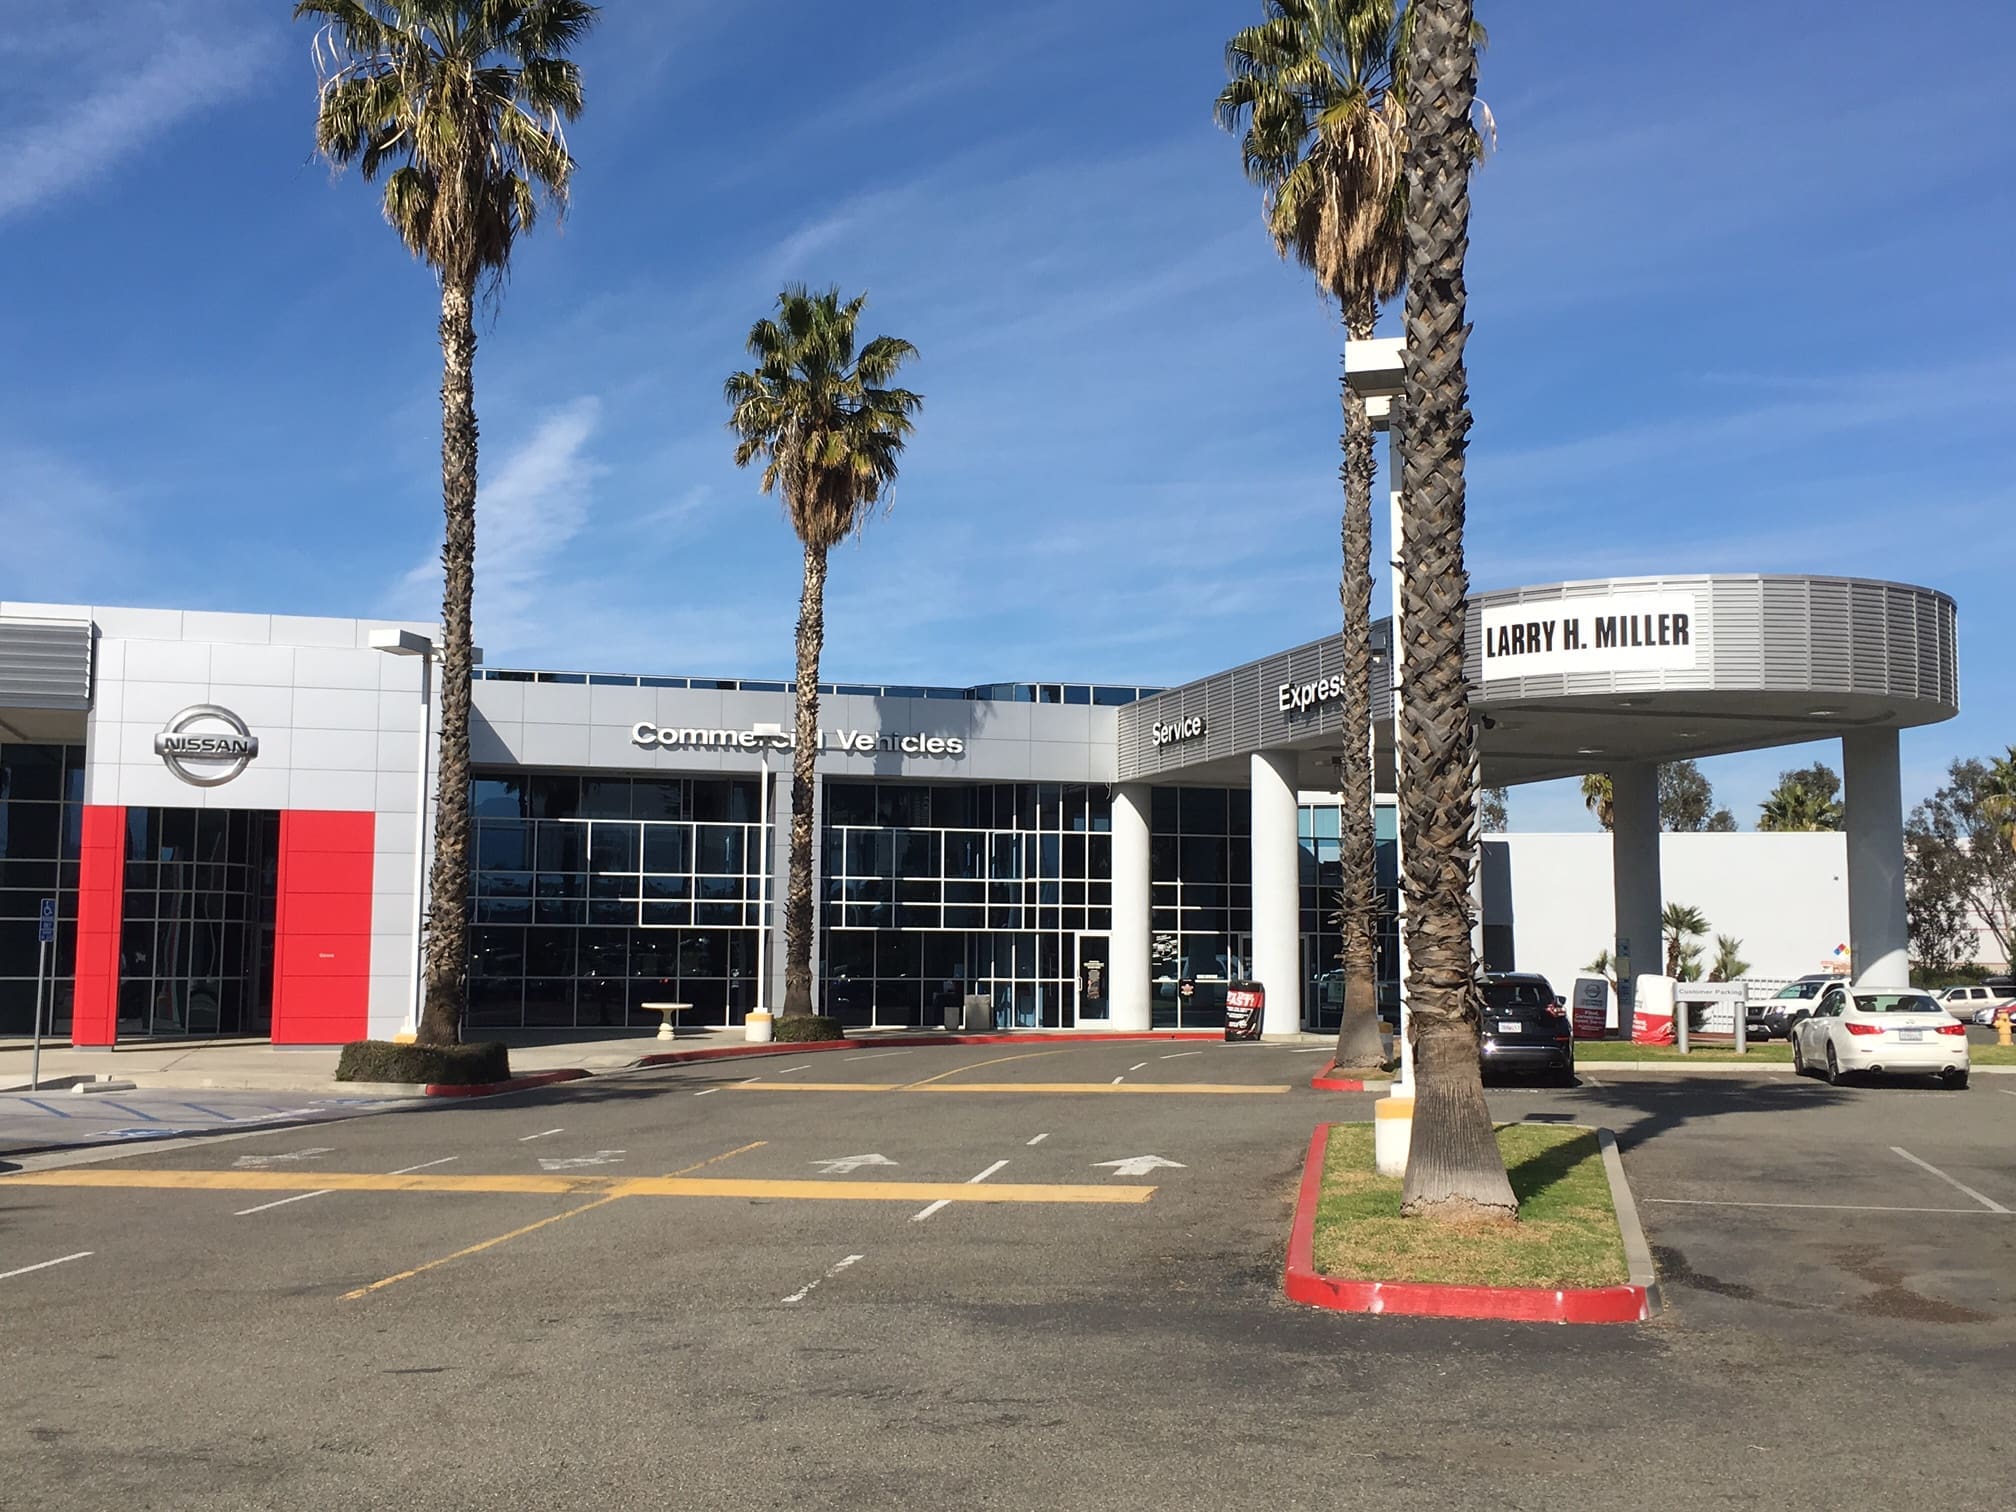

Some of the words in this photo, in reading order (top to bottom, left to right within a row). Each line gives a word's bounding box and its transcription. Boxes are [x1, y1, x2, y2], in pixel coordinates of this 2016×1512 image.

[1486, 620, 1556, 658] LARRY
[1563, 618, 1588, 650] H.
[1595, 613, 1690, 648] MILLER
[164, 737, 248, 752] NISSAN
[631, 721, 823, 749] Commecil
[836, 729, 963, 753] Vehicles
[1152, 716, 1202, 746] Service
[1715, 988, 1743, 996] Parking
